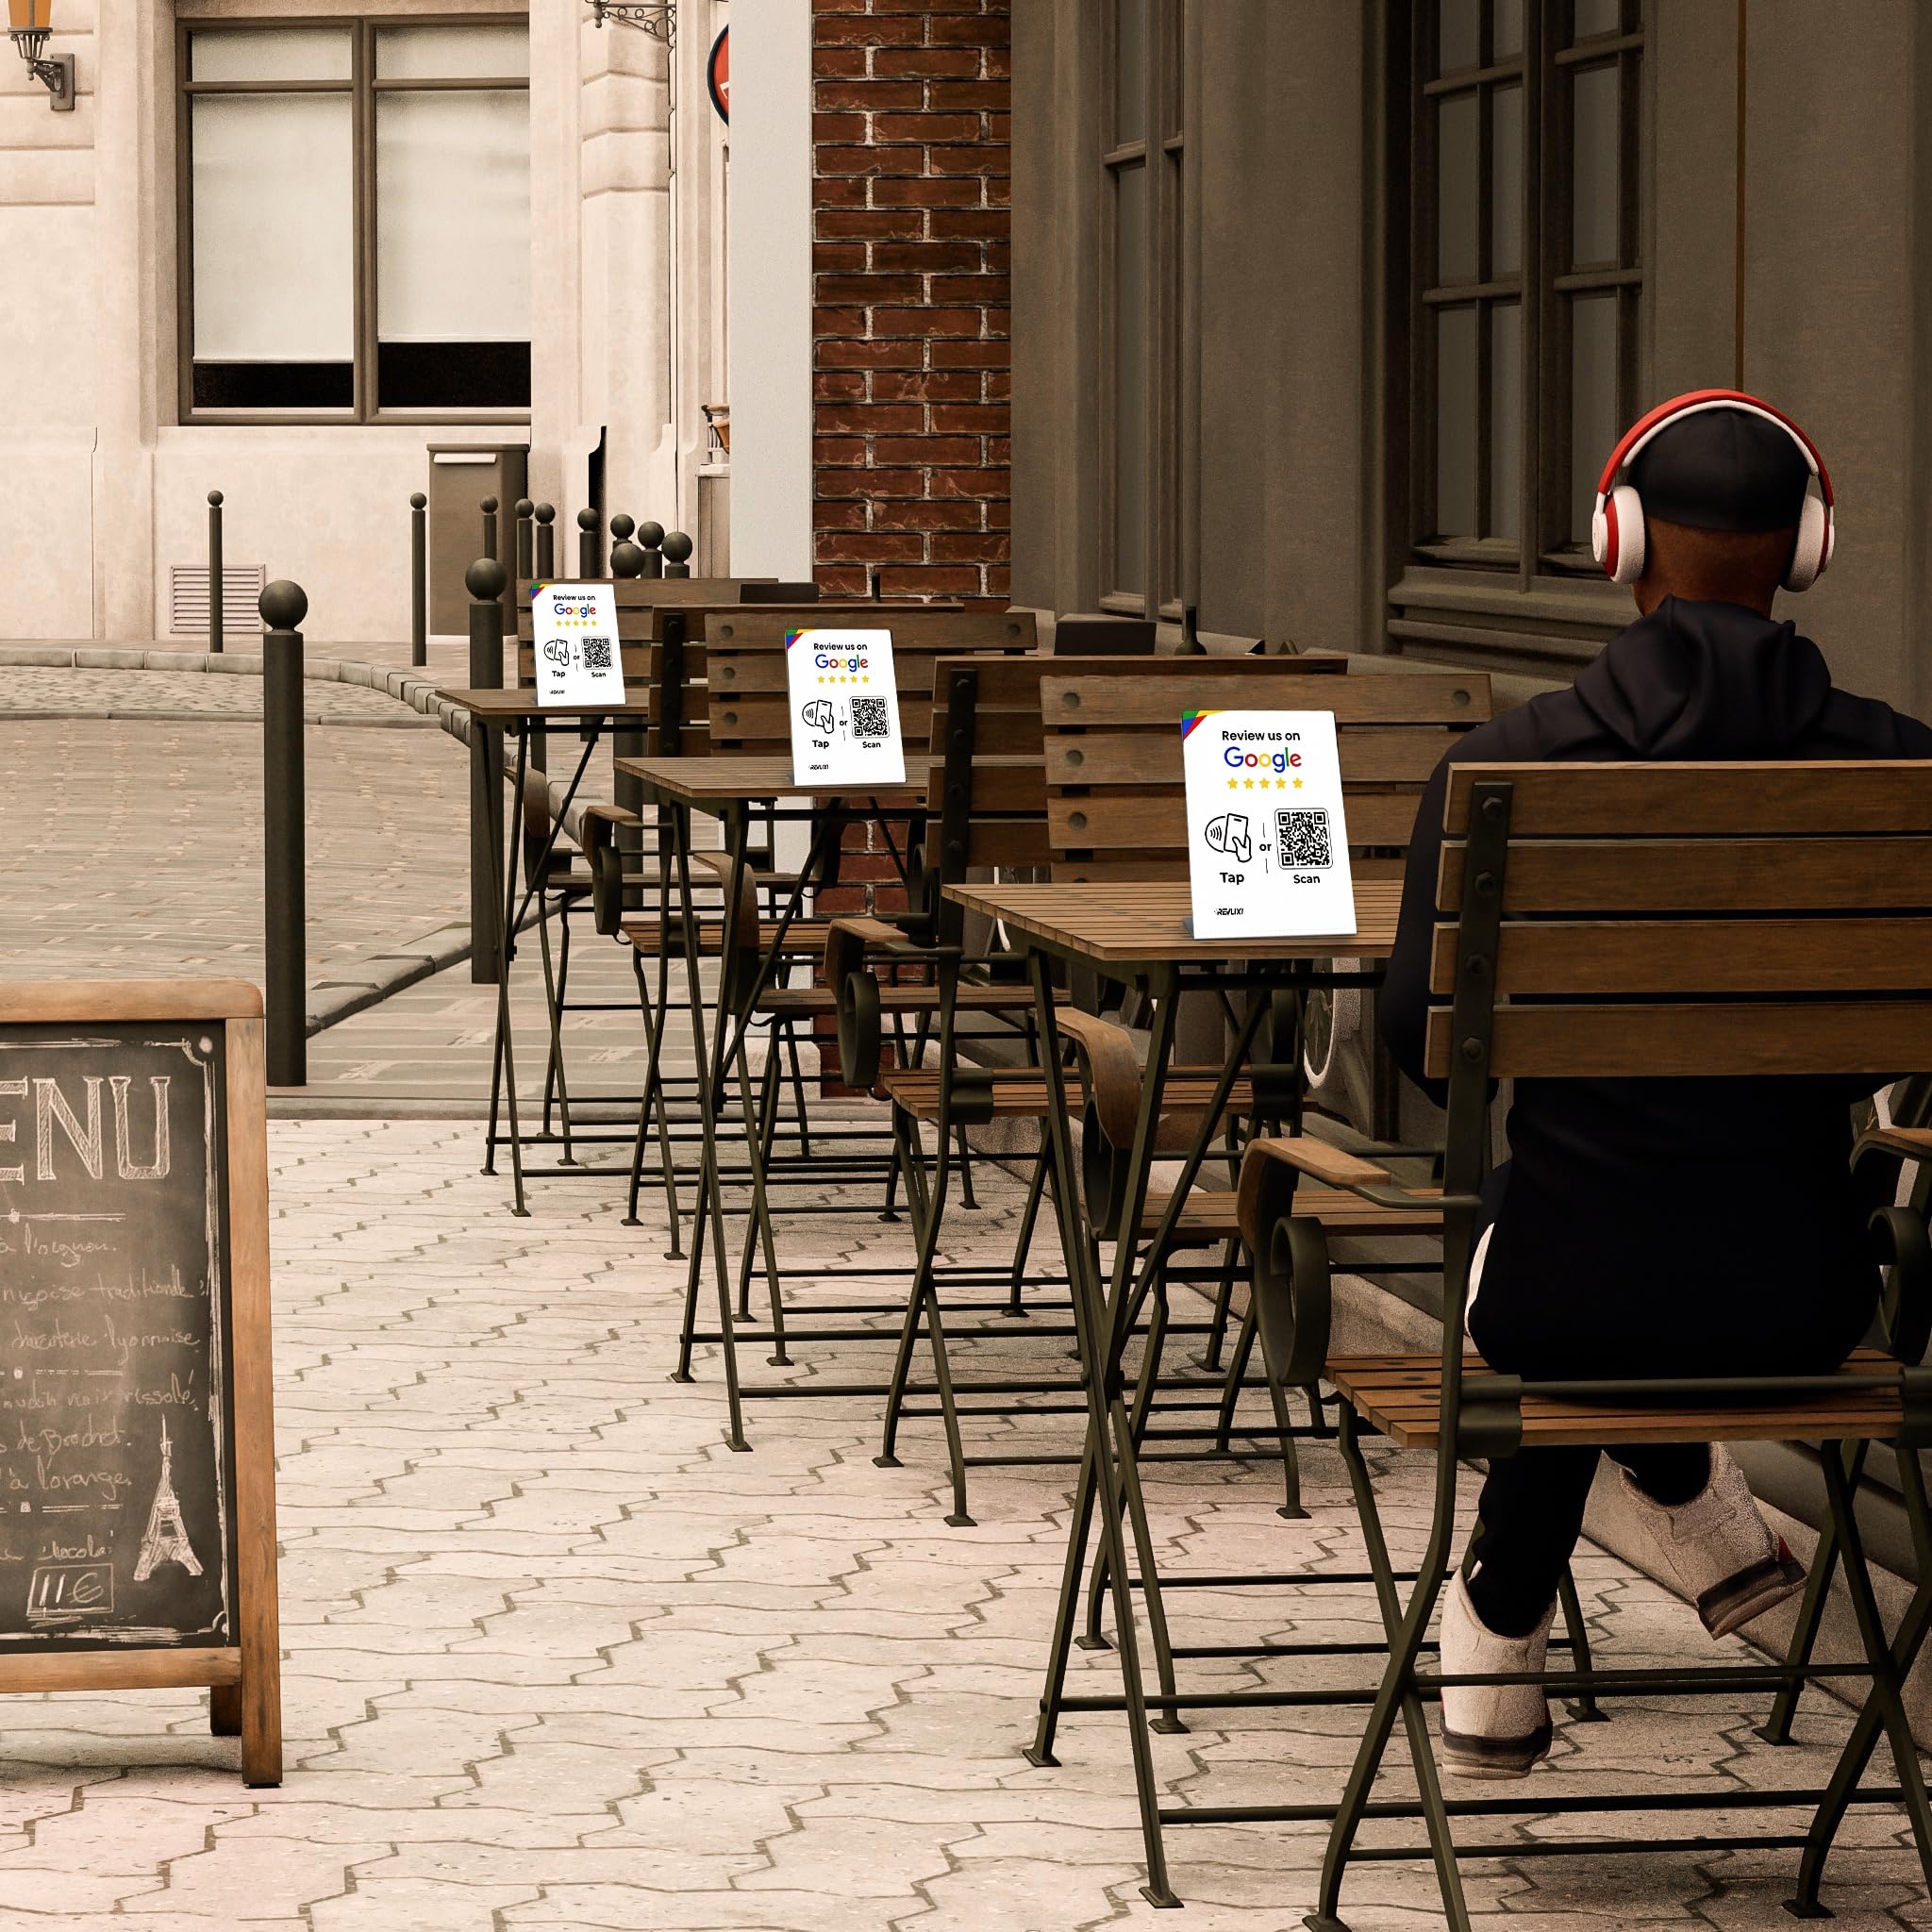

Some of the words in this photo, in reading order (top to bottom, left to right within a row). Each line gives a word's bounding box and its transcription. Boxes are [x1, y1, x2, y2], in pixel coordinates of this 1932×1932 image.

[552, 593, 577, 602] Review
[554, 603, 597, 619] Google
[813, 641, 844, 651] Review
[814, 653, 869, 673] Google
[551, 670, 566, 679] Tap
[1222, 730, 1265, 741] Review
[1268, 732, 1282, 741] us
[1285, 732, 1301, 741] on
[811, 740, 830, 750] Tap
[861, 741, 882, 749] Scan
[1224, 746, 1302, 773] Google
[1220, 873, 1244, 885] Tap
[1293, 874, 1321, 884] Scan
